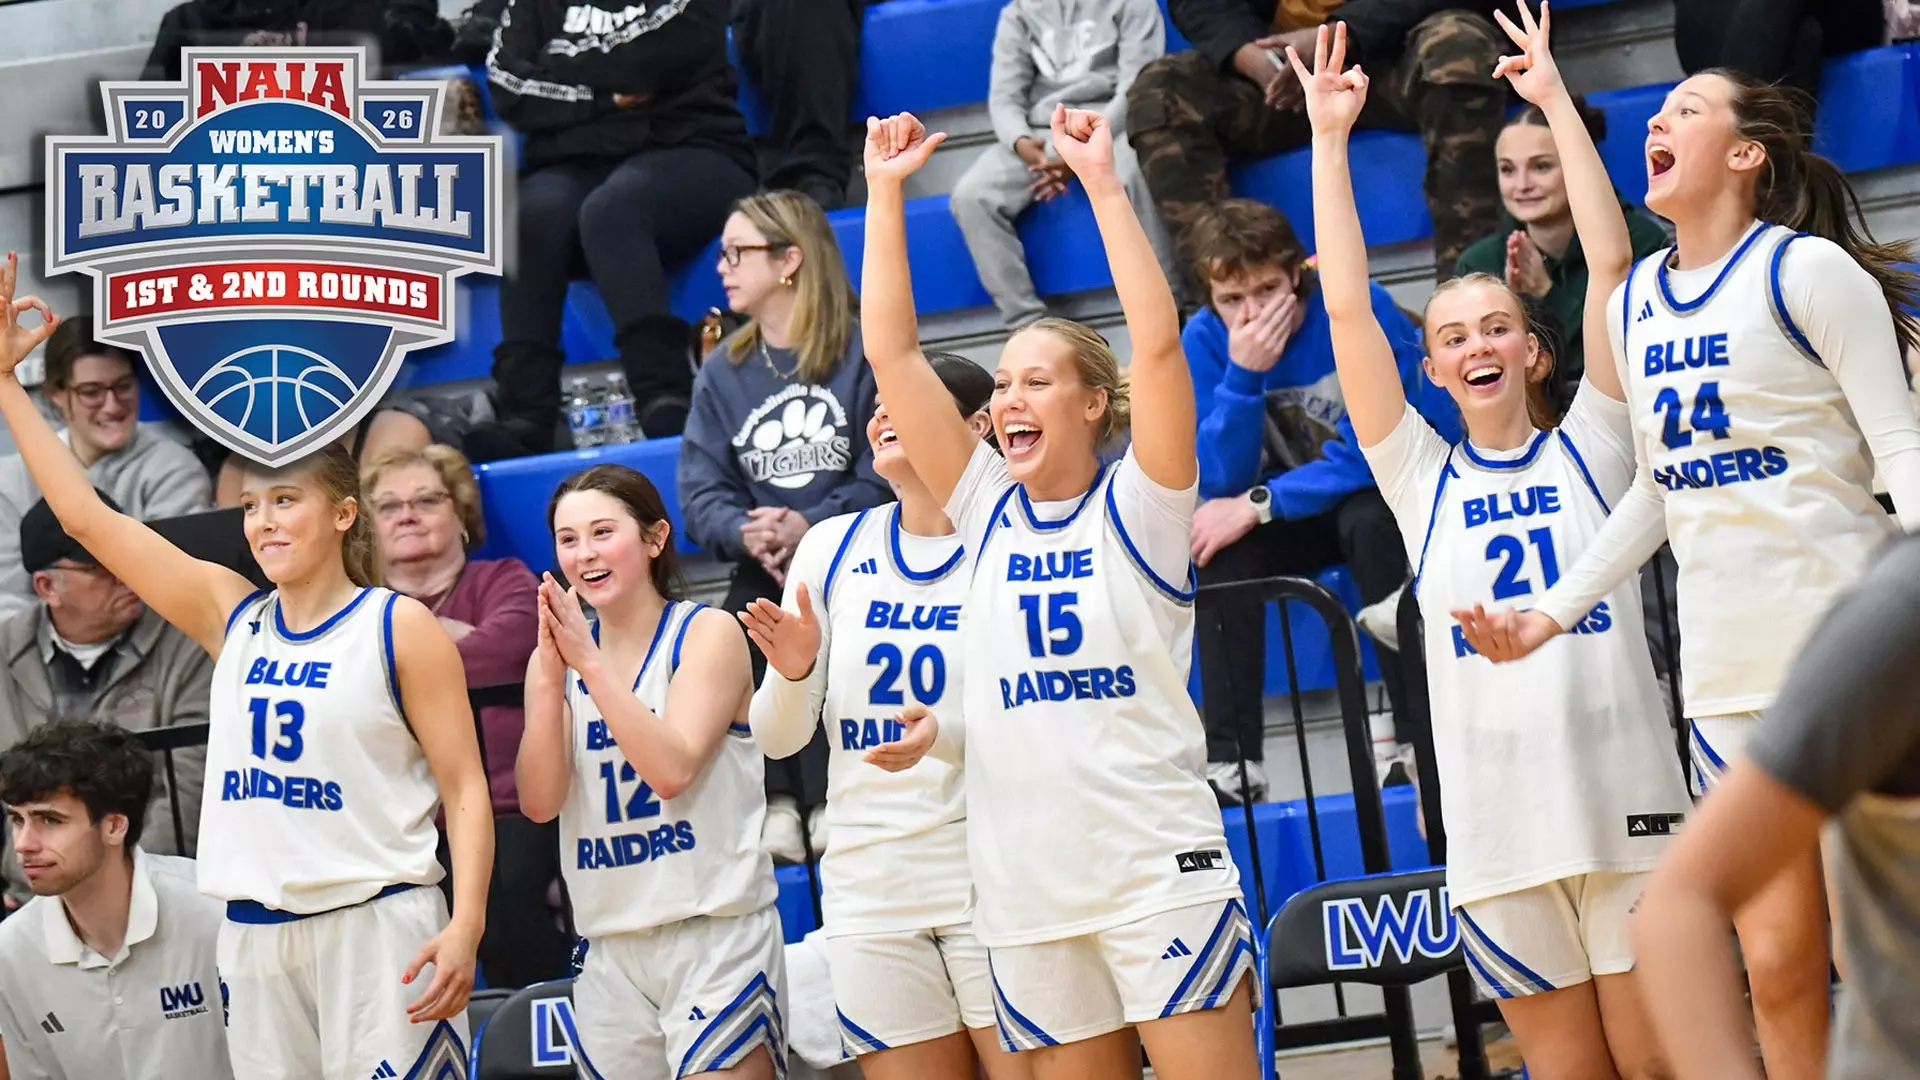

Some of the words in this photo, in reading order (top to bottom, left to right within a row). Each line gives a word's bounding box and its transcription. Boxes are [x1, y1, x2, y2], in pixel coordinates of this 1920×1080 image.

[1644, 332, 1730, 378] BLUE
[1653, 380, 1731, 450] 24
[738, 436, 852, 483] TIGERS
[1462, 485, 1562, 529] BLUE
[1006, 547, 1094, 583] BLUE
[1484, 525, 1561, 603] 21
[864, 600, 963, 632] BLUE
[1018, 591, 1084, 659] 15
[245, 656, 333, 689] BLUE
[865, 641, 947, 707] 20
[999, 664, 1137, 711] RAIDERS
[248, 697, 306, 764] 13
[221, 767, 344, 812] RAIDERS
[599, 759, 662, 825] 12
[576, 819, 697, 870] RAIDERS
[1322, 886, 1461, 971] LWU
[160, 982, 204, 1012] LWU
